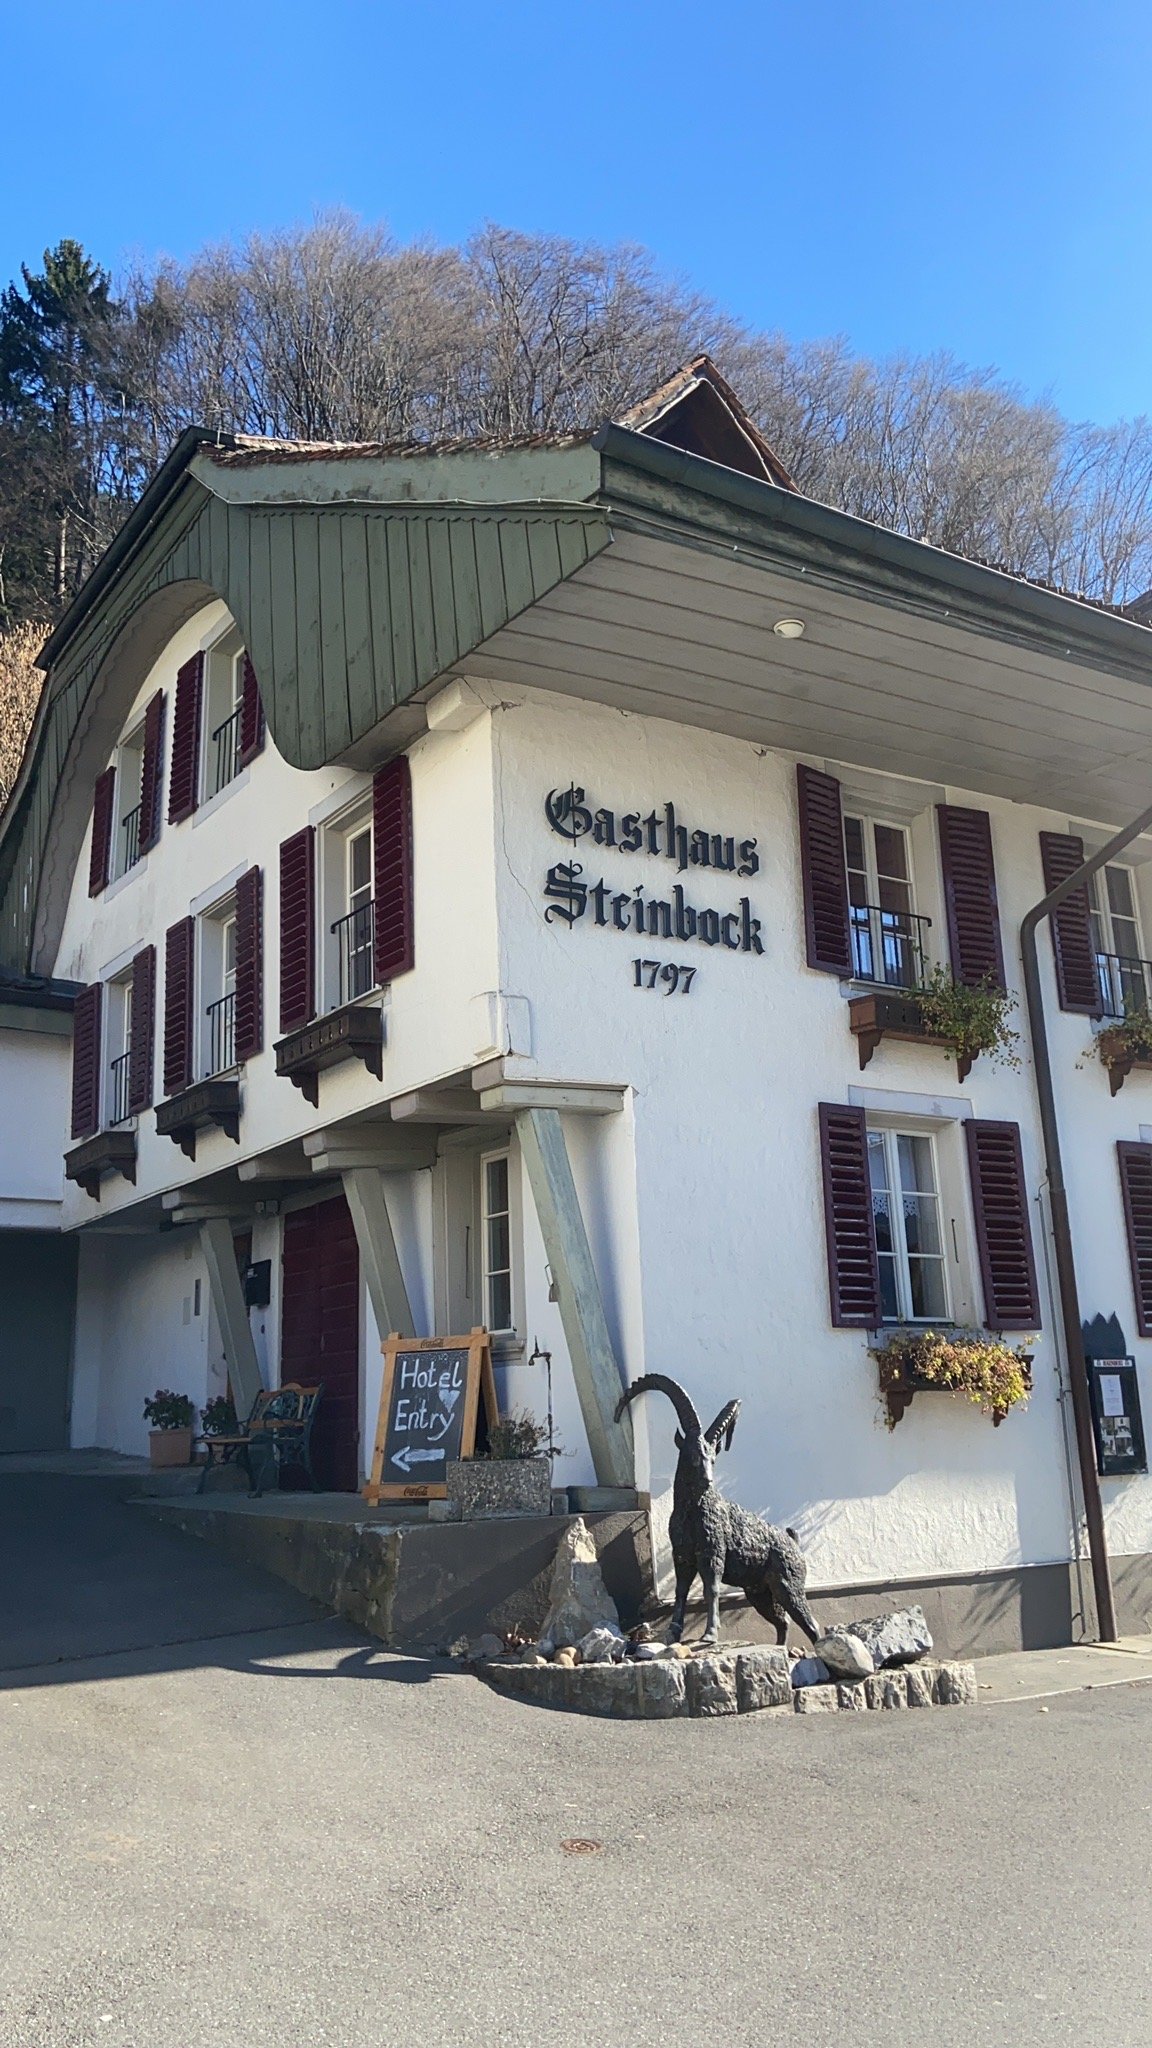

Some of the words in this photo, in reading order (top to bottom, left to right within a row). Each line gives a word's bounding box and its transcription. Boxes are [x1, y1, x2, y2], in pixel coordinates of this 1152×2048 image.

[545, 781, 760, 877] Gasthaus
[544, 860, 765, 955] Steinbock
[632, 958, 697, 996] 1797
[401, 1360, 462, 1389] Hotel
[394, 1399, 455, 1441] Entry
